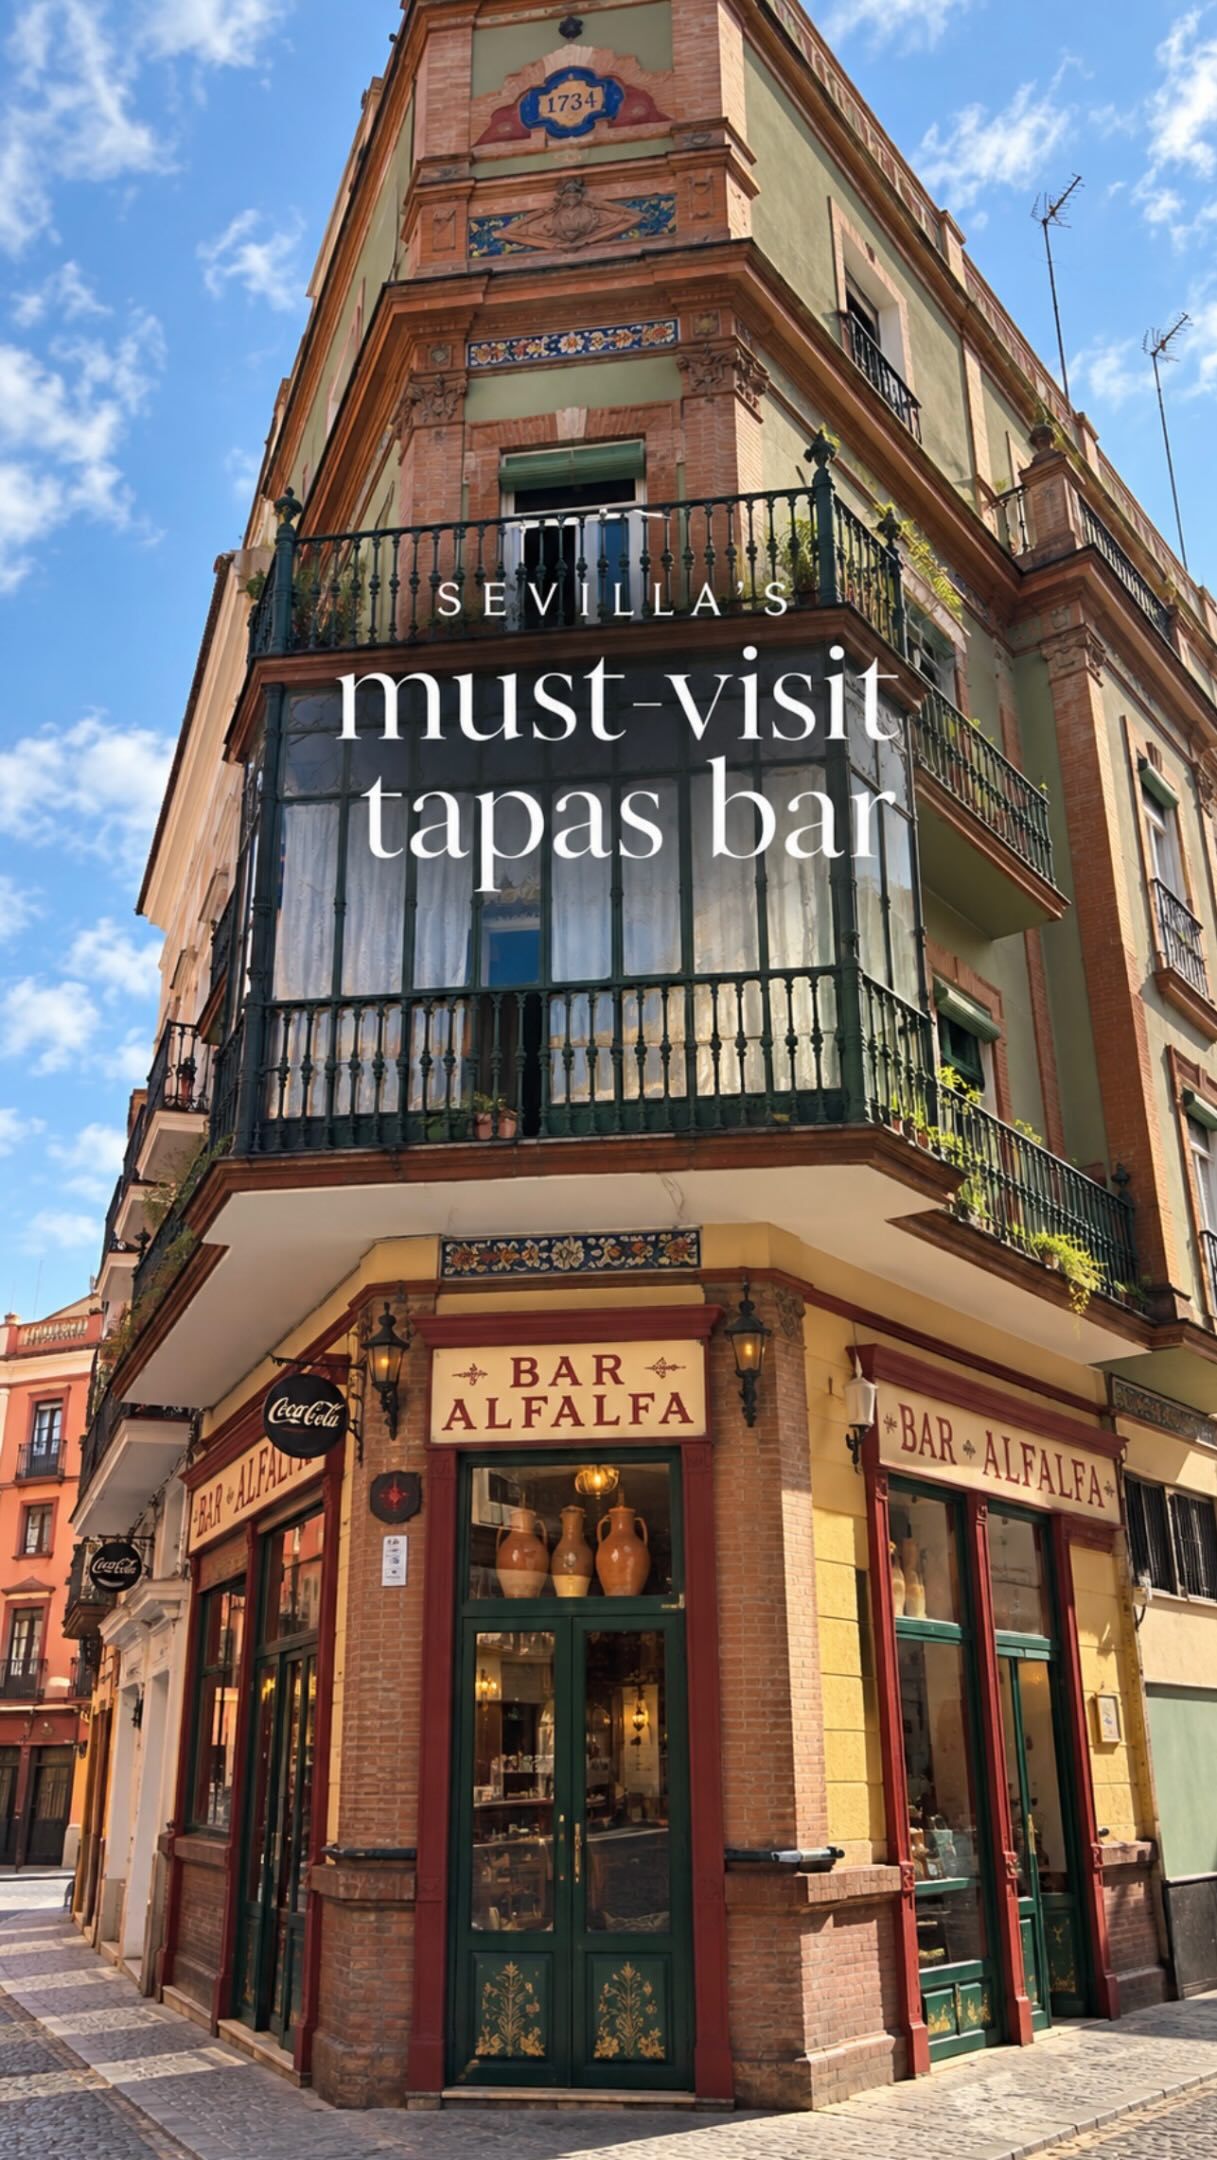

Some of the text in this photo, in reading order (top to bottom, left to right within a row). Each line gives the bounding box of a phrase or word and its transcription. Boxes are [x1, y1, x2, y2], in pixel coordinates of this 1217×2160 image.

[547, 90, 597, 113] 1734
[510, 1354, 625, 1388] BAR
[441, 1391, 694, 1431] ALFALFA
[898, 1403, 1106, 1509] BAR ALFALFA
[196, 1446, 312, 1538] BAR ALFAL
